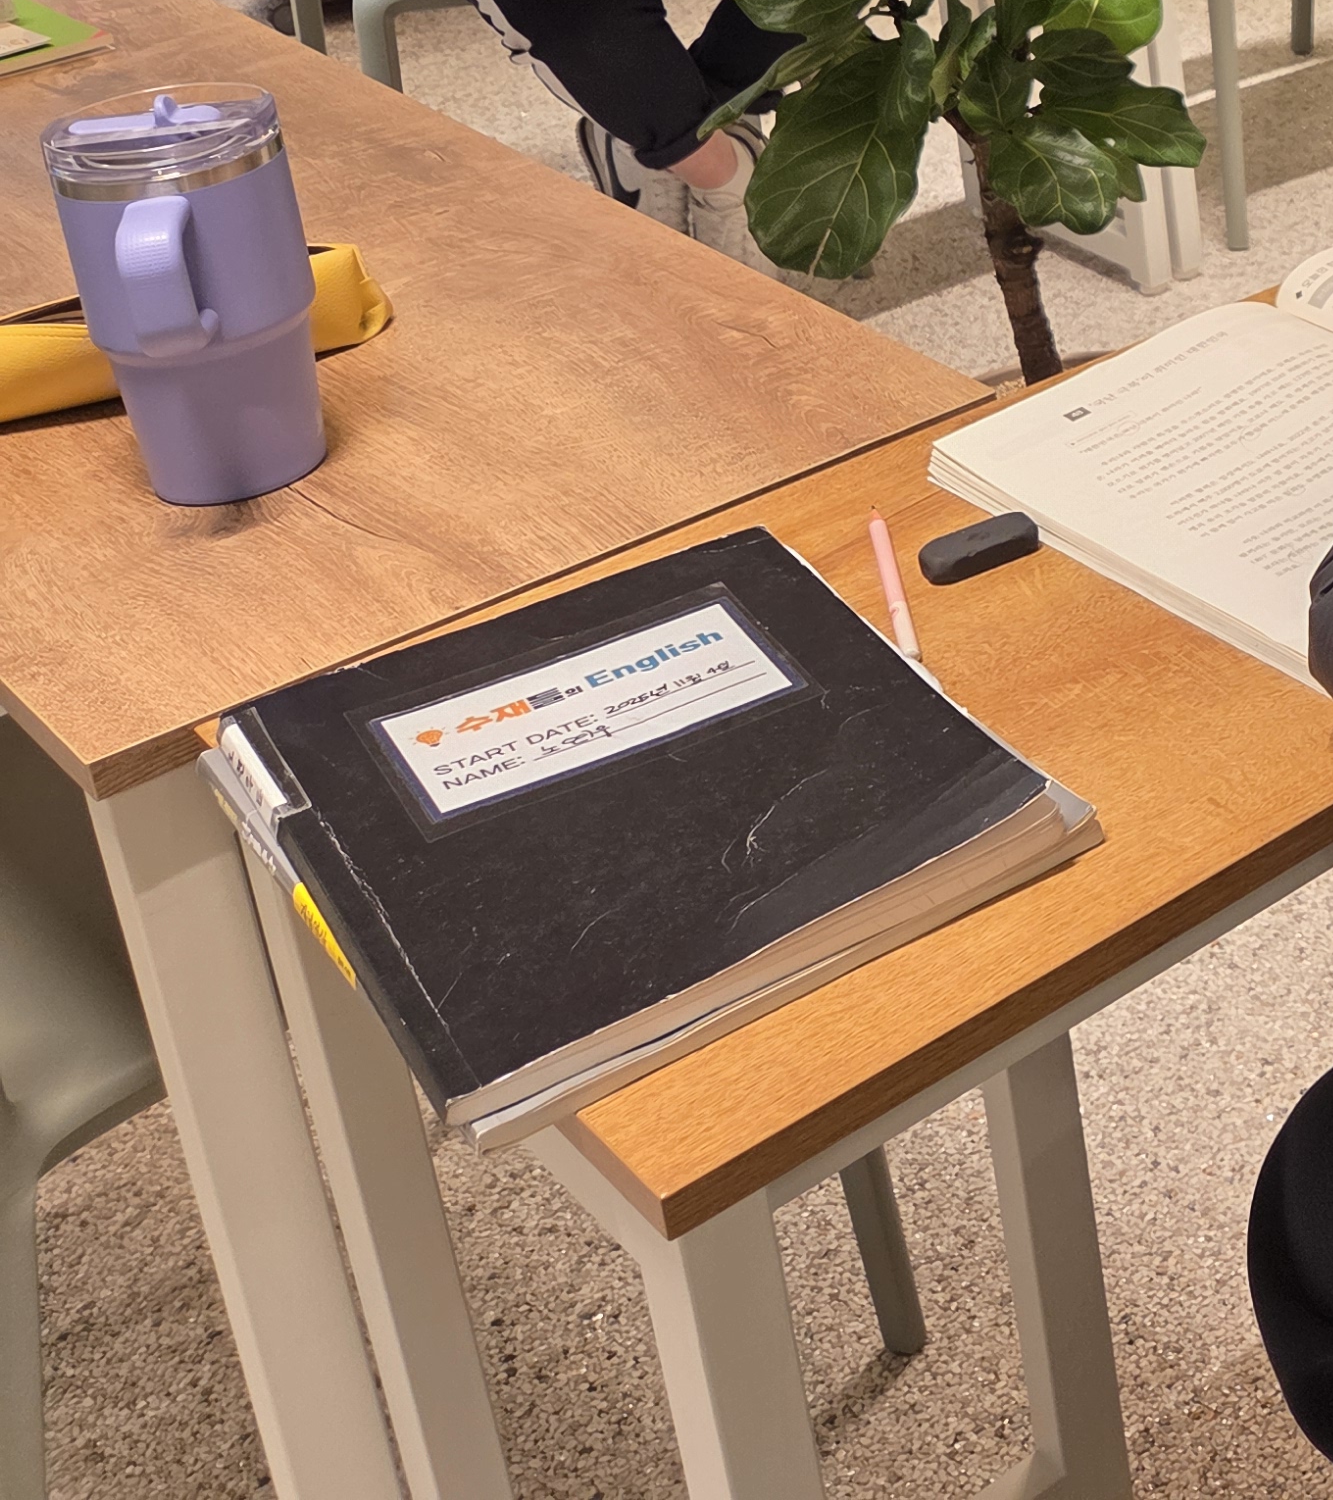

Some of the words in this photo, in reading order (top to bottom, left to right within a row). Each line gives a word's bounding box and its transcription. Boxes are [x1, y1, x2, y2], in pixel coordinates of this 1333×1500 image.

[585, 630, 724, 688] English
[433, 741, 518, 777] START
[526, 711, 600, 746] DATE:
[442, 755, 525, 791] NAME:
